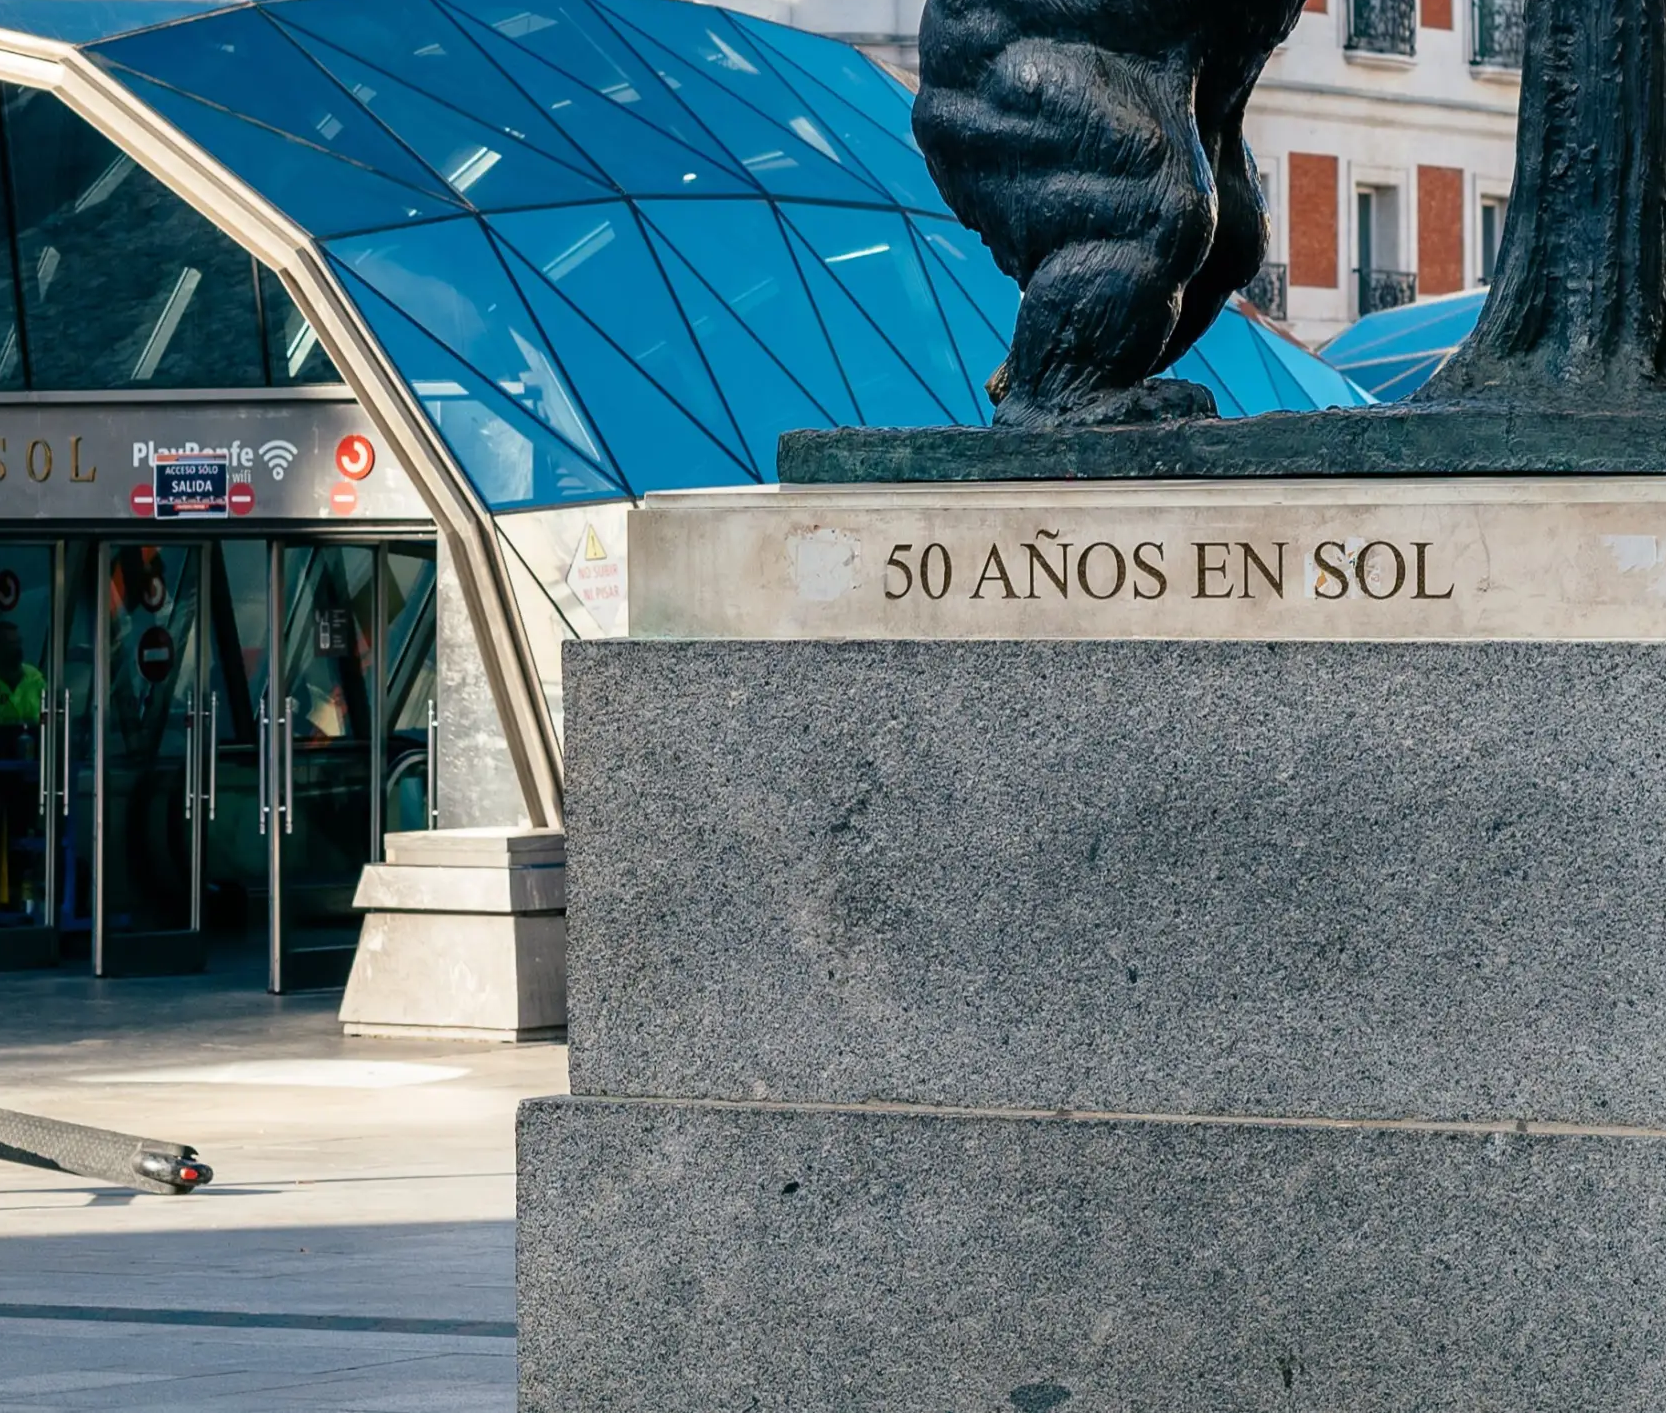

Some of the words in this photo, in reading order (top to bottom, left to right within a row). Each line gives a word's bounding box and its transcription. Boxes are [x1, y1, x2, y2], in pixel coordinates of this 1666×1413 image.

[164, 466, 196, 476] ACCESO
[197, 464, 219, 475] SÓLO
[232, 470, 252, 483] wifi
[171, 479, 214, 493] SALIDA
[884, 544, 953, 600] 50
[969, 528, 1168, 600] AÑOS
[1190, 542, 1290, 600] EN
[1314, 541, 1456, 600] SOL
